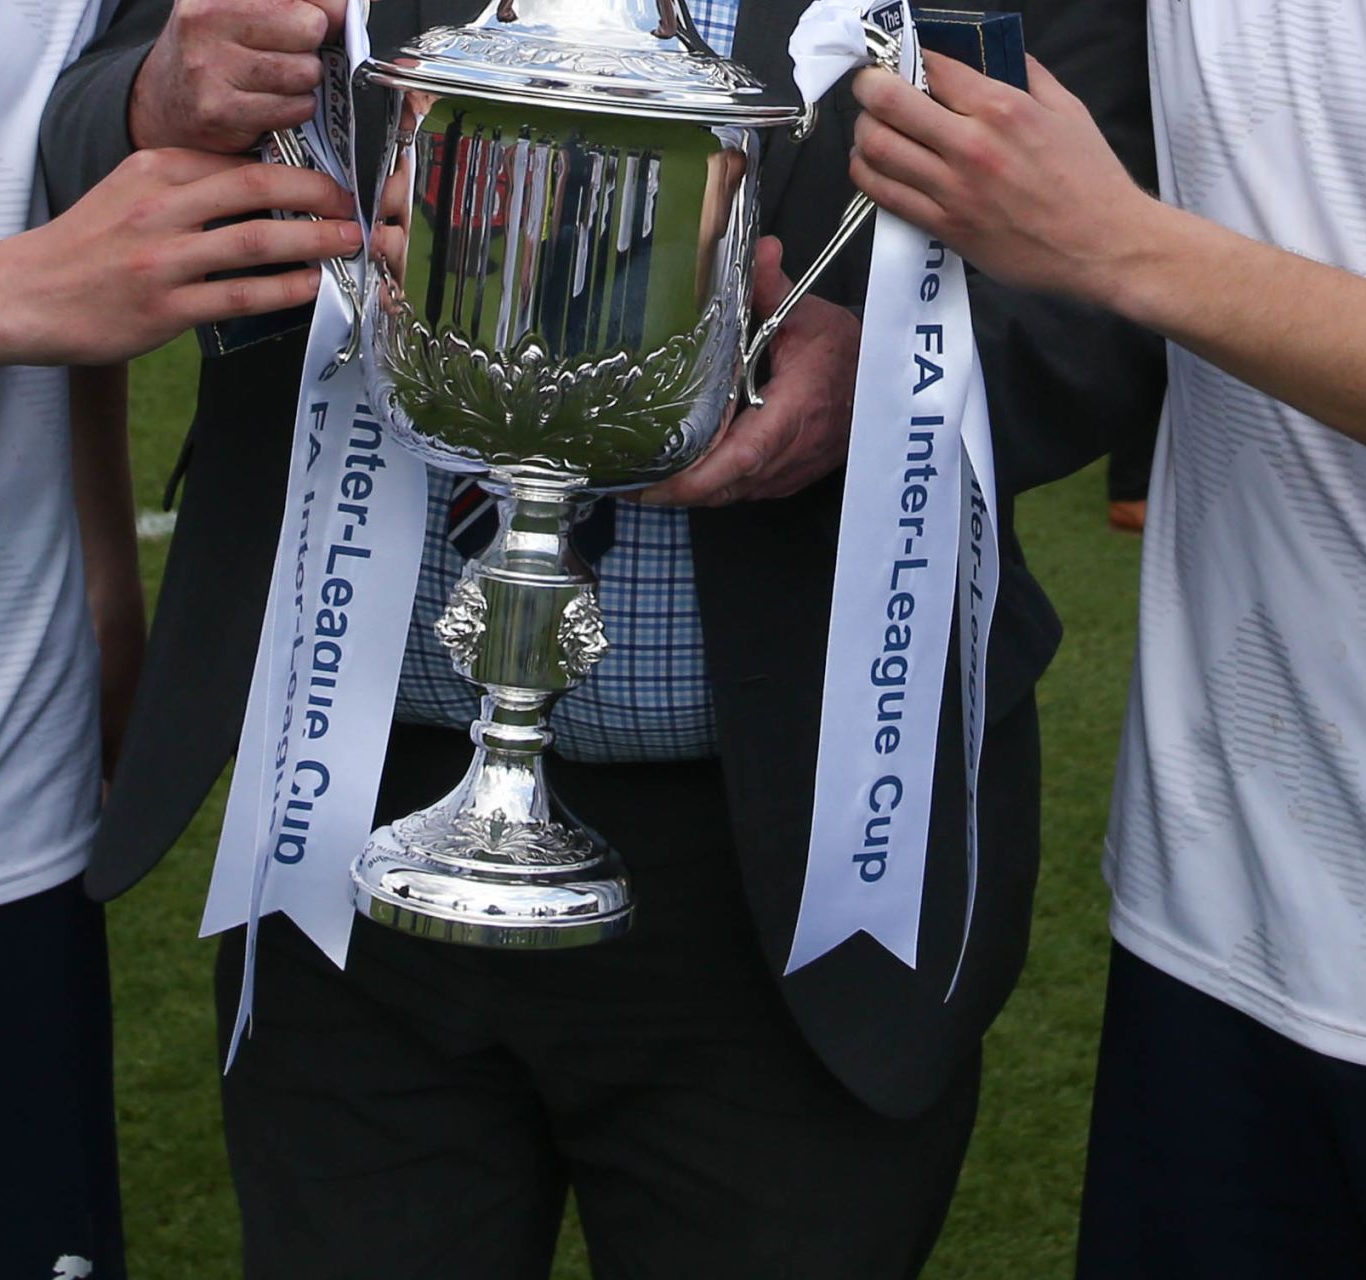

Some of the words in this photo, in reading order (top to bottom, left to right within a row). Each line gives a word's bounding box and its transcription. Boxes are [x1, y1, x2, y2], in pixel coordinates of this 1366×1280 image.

[881, 10, 900, 31] The
[912, 324, 944, 395] FA
[305, 401, 329, 472] FA
[870, 415, 945, 756] Inter-League
[273, 760, 331, 866] Cup
[852, 775, 903, 884] Cup
